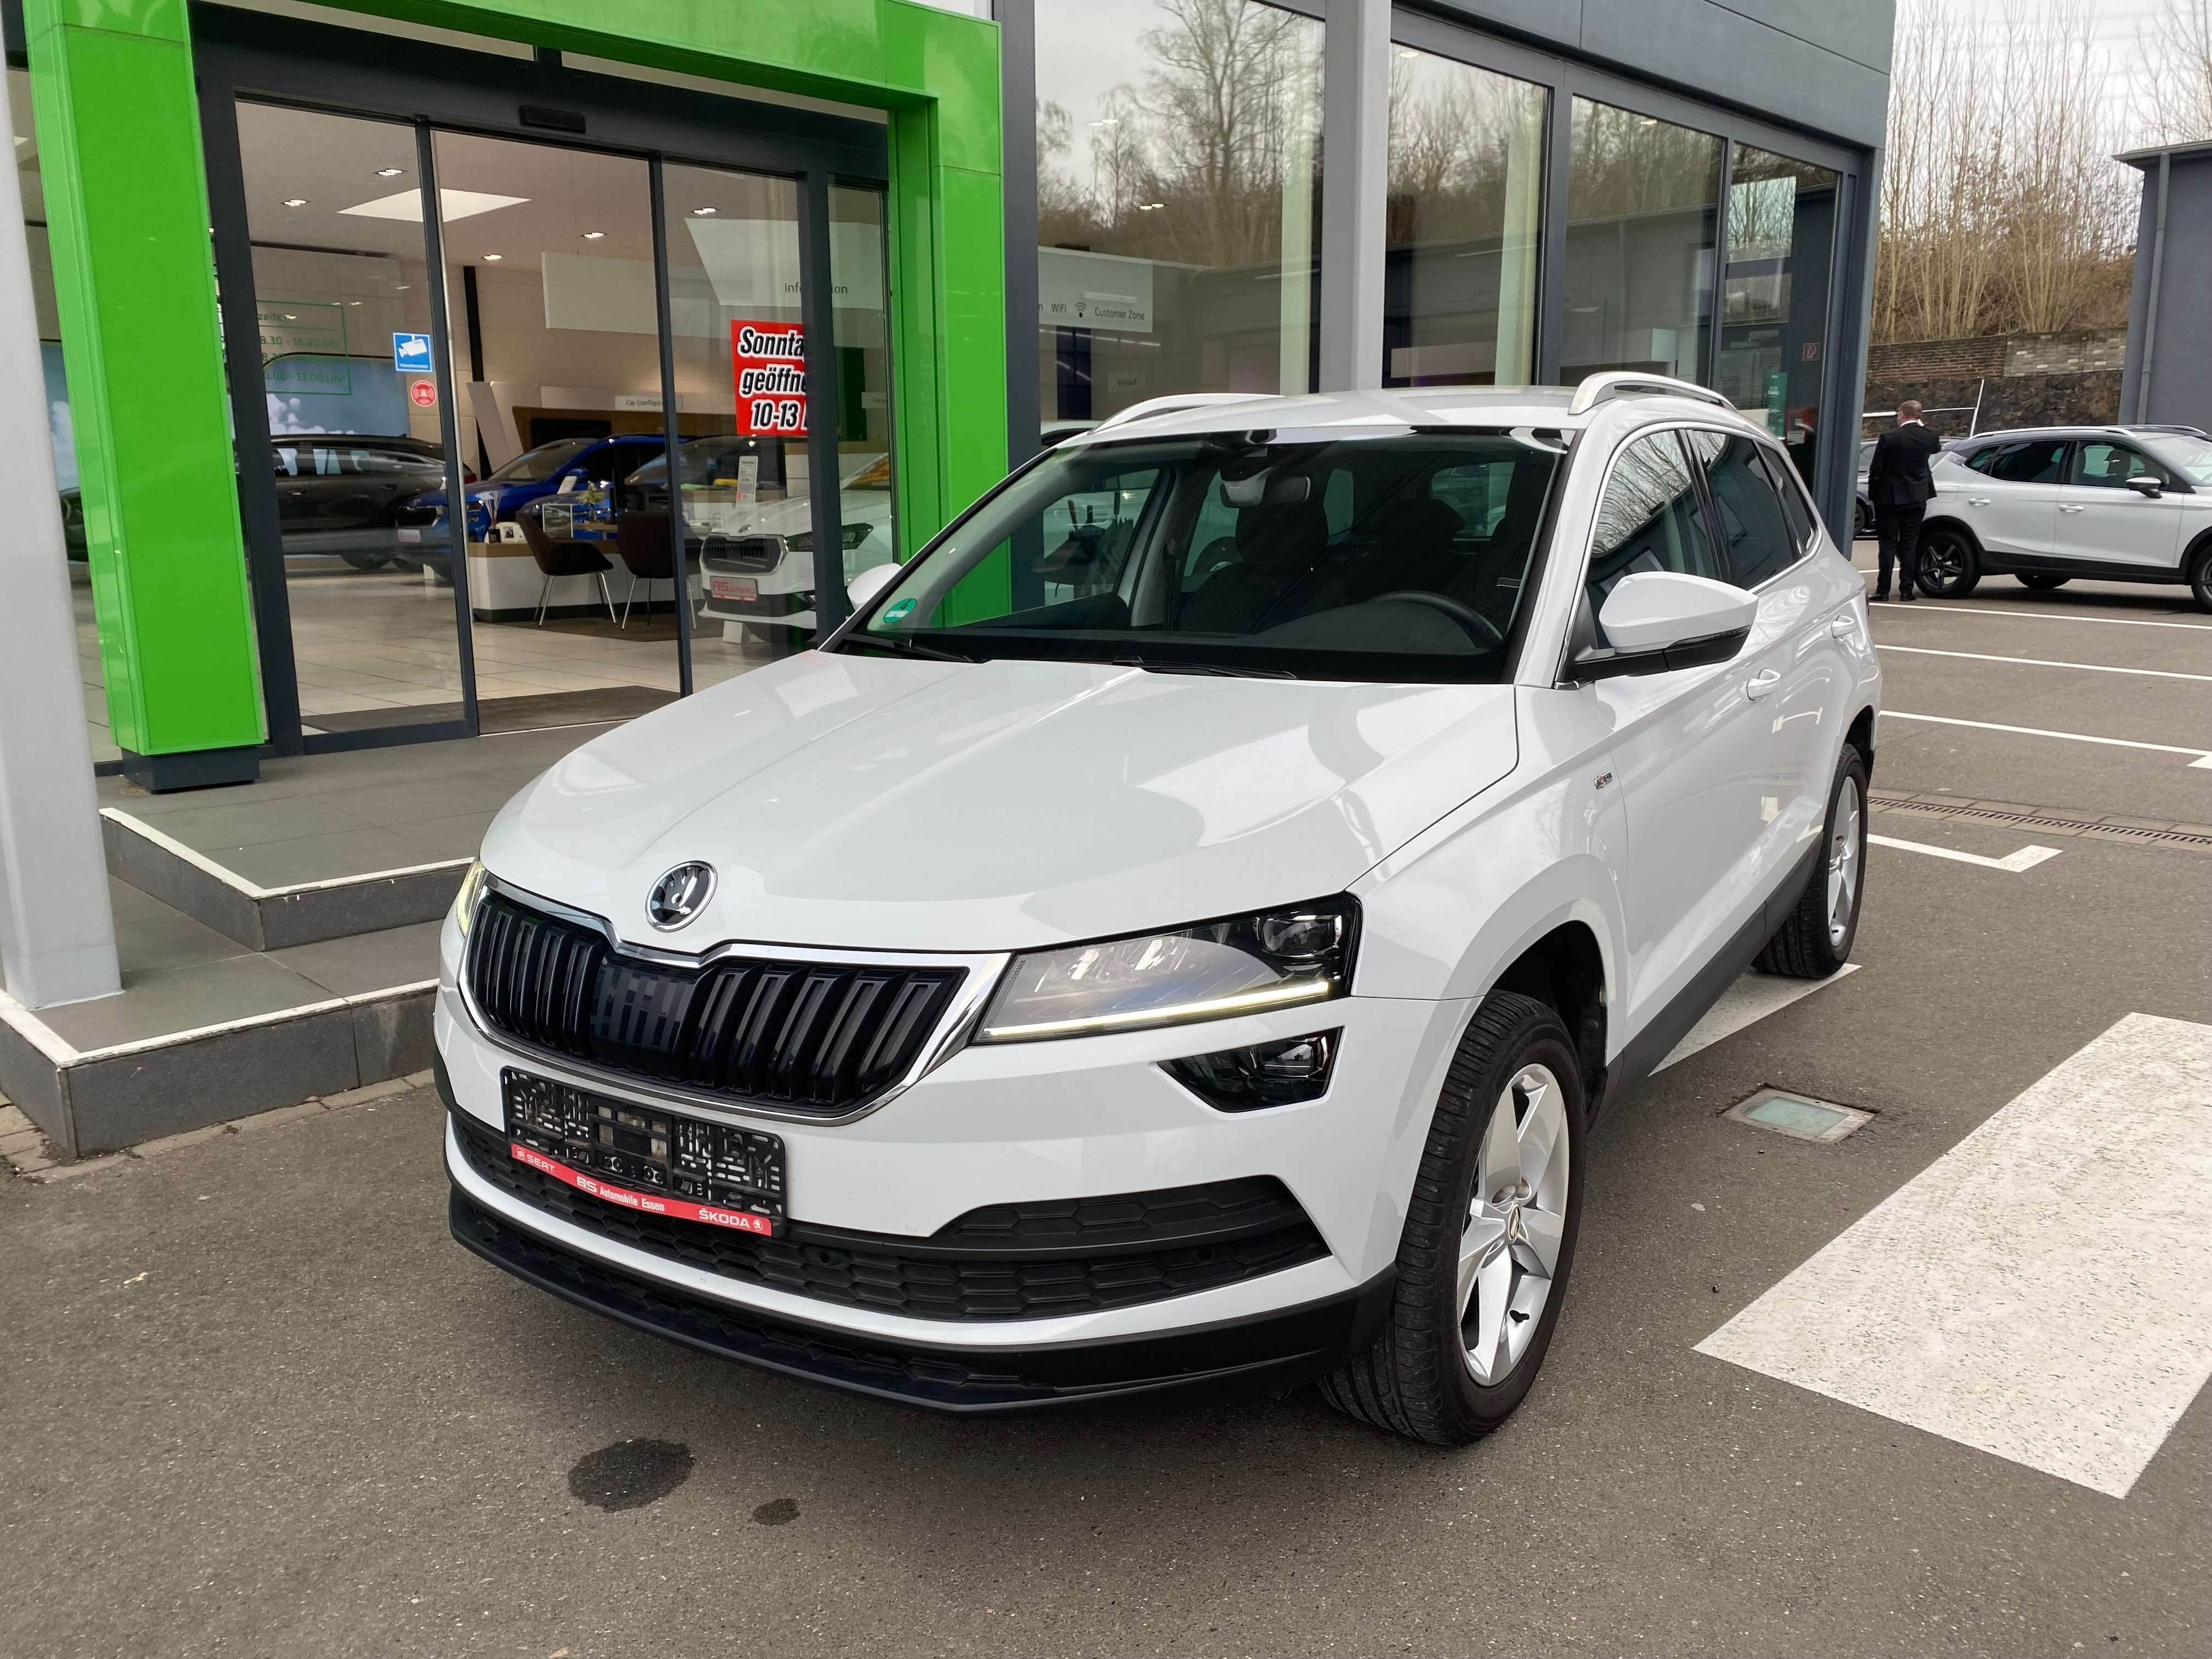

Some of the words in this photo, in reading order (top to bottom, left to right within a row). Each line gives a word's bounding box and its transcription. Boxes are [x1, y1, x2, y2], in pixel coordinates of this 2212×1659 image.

[1051, 302, 1066, 313] WiFi
[1094, 307, 1126, 319] Customer
[1128, 310, 1146, 320] Zone
[753, 402, 798, 427] 10-13
[527, 1154, 555, 1173] SEAT
[600, 1186, 638, 1206] Automobile
[641, 1198, 664, 1212] Essen
[698, 1207, 751, 1229] ŠKODA
